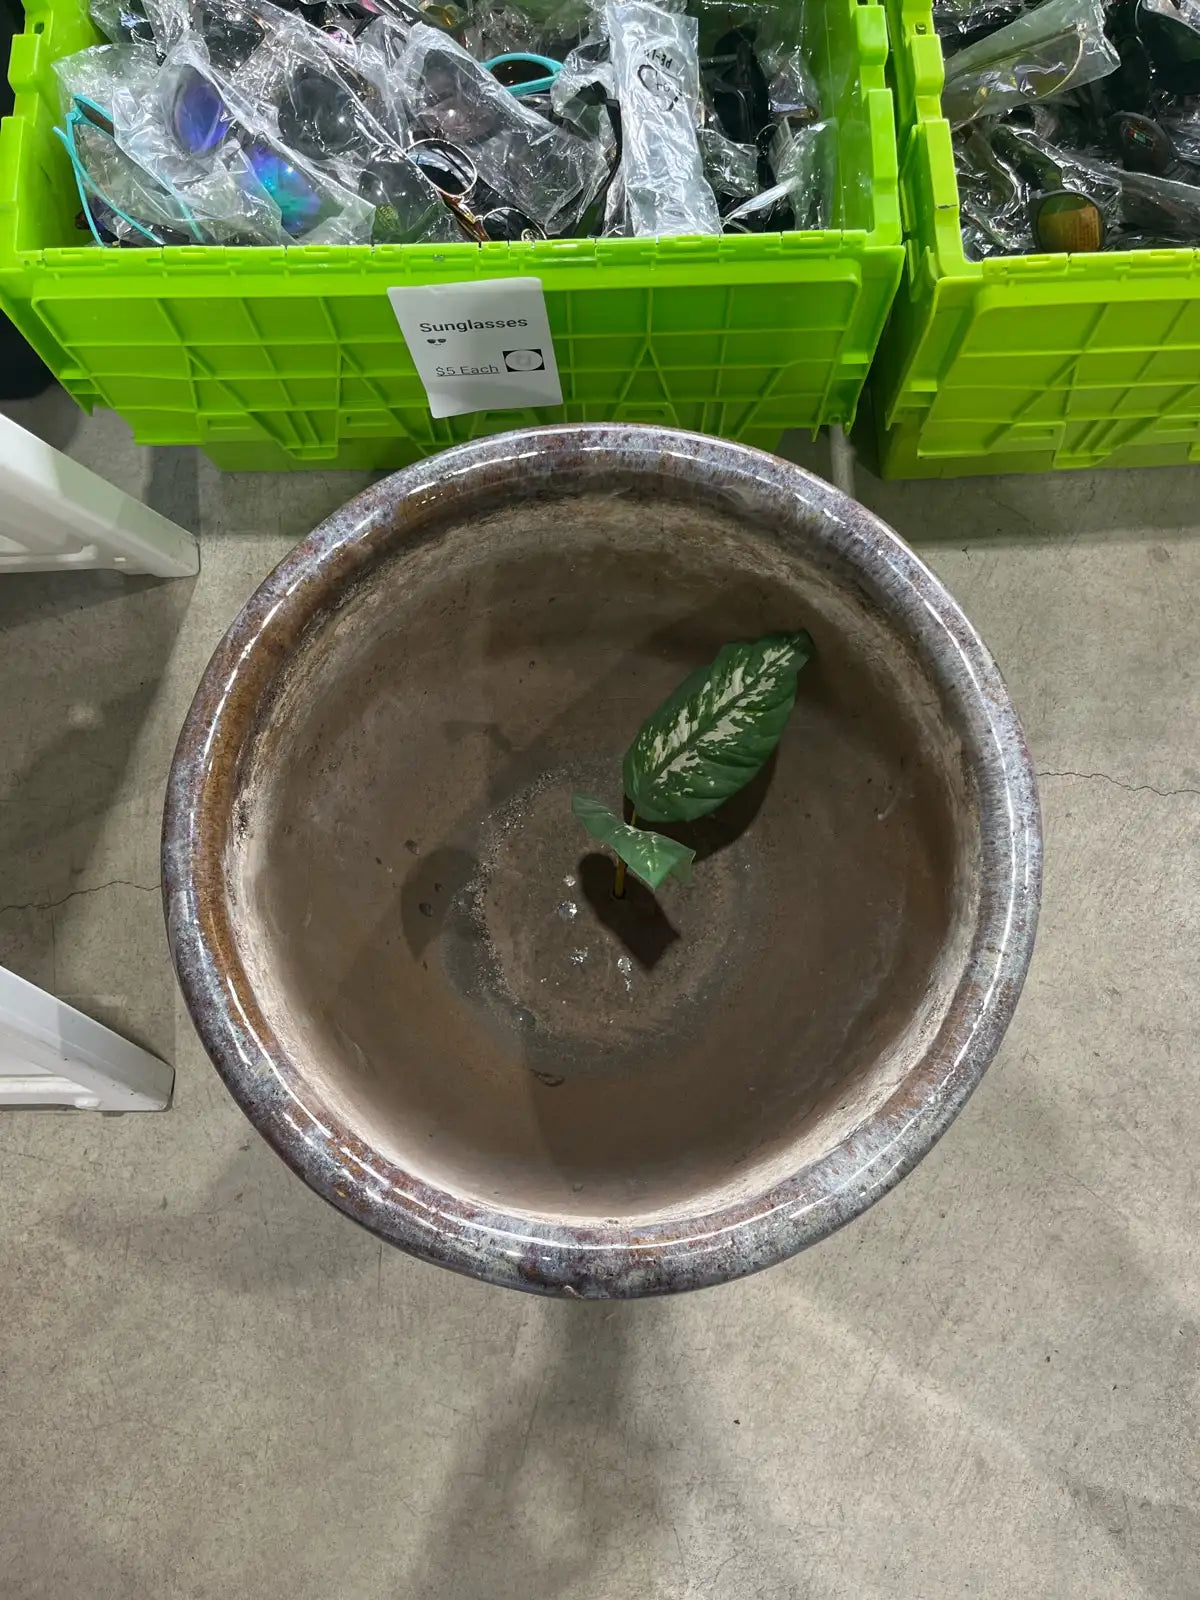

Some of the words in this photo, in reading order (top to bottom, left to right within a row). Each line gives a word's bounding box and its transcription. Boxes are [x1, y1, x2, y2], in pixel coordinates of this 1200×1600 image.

[419, 319, 528, 332] Sunglasses
[435, 366, 456, 377] $5
[459, 364, 499, 375] Each
